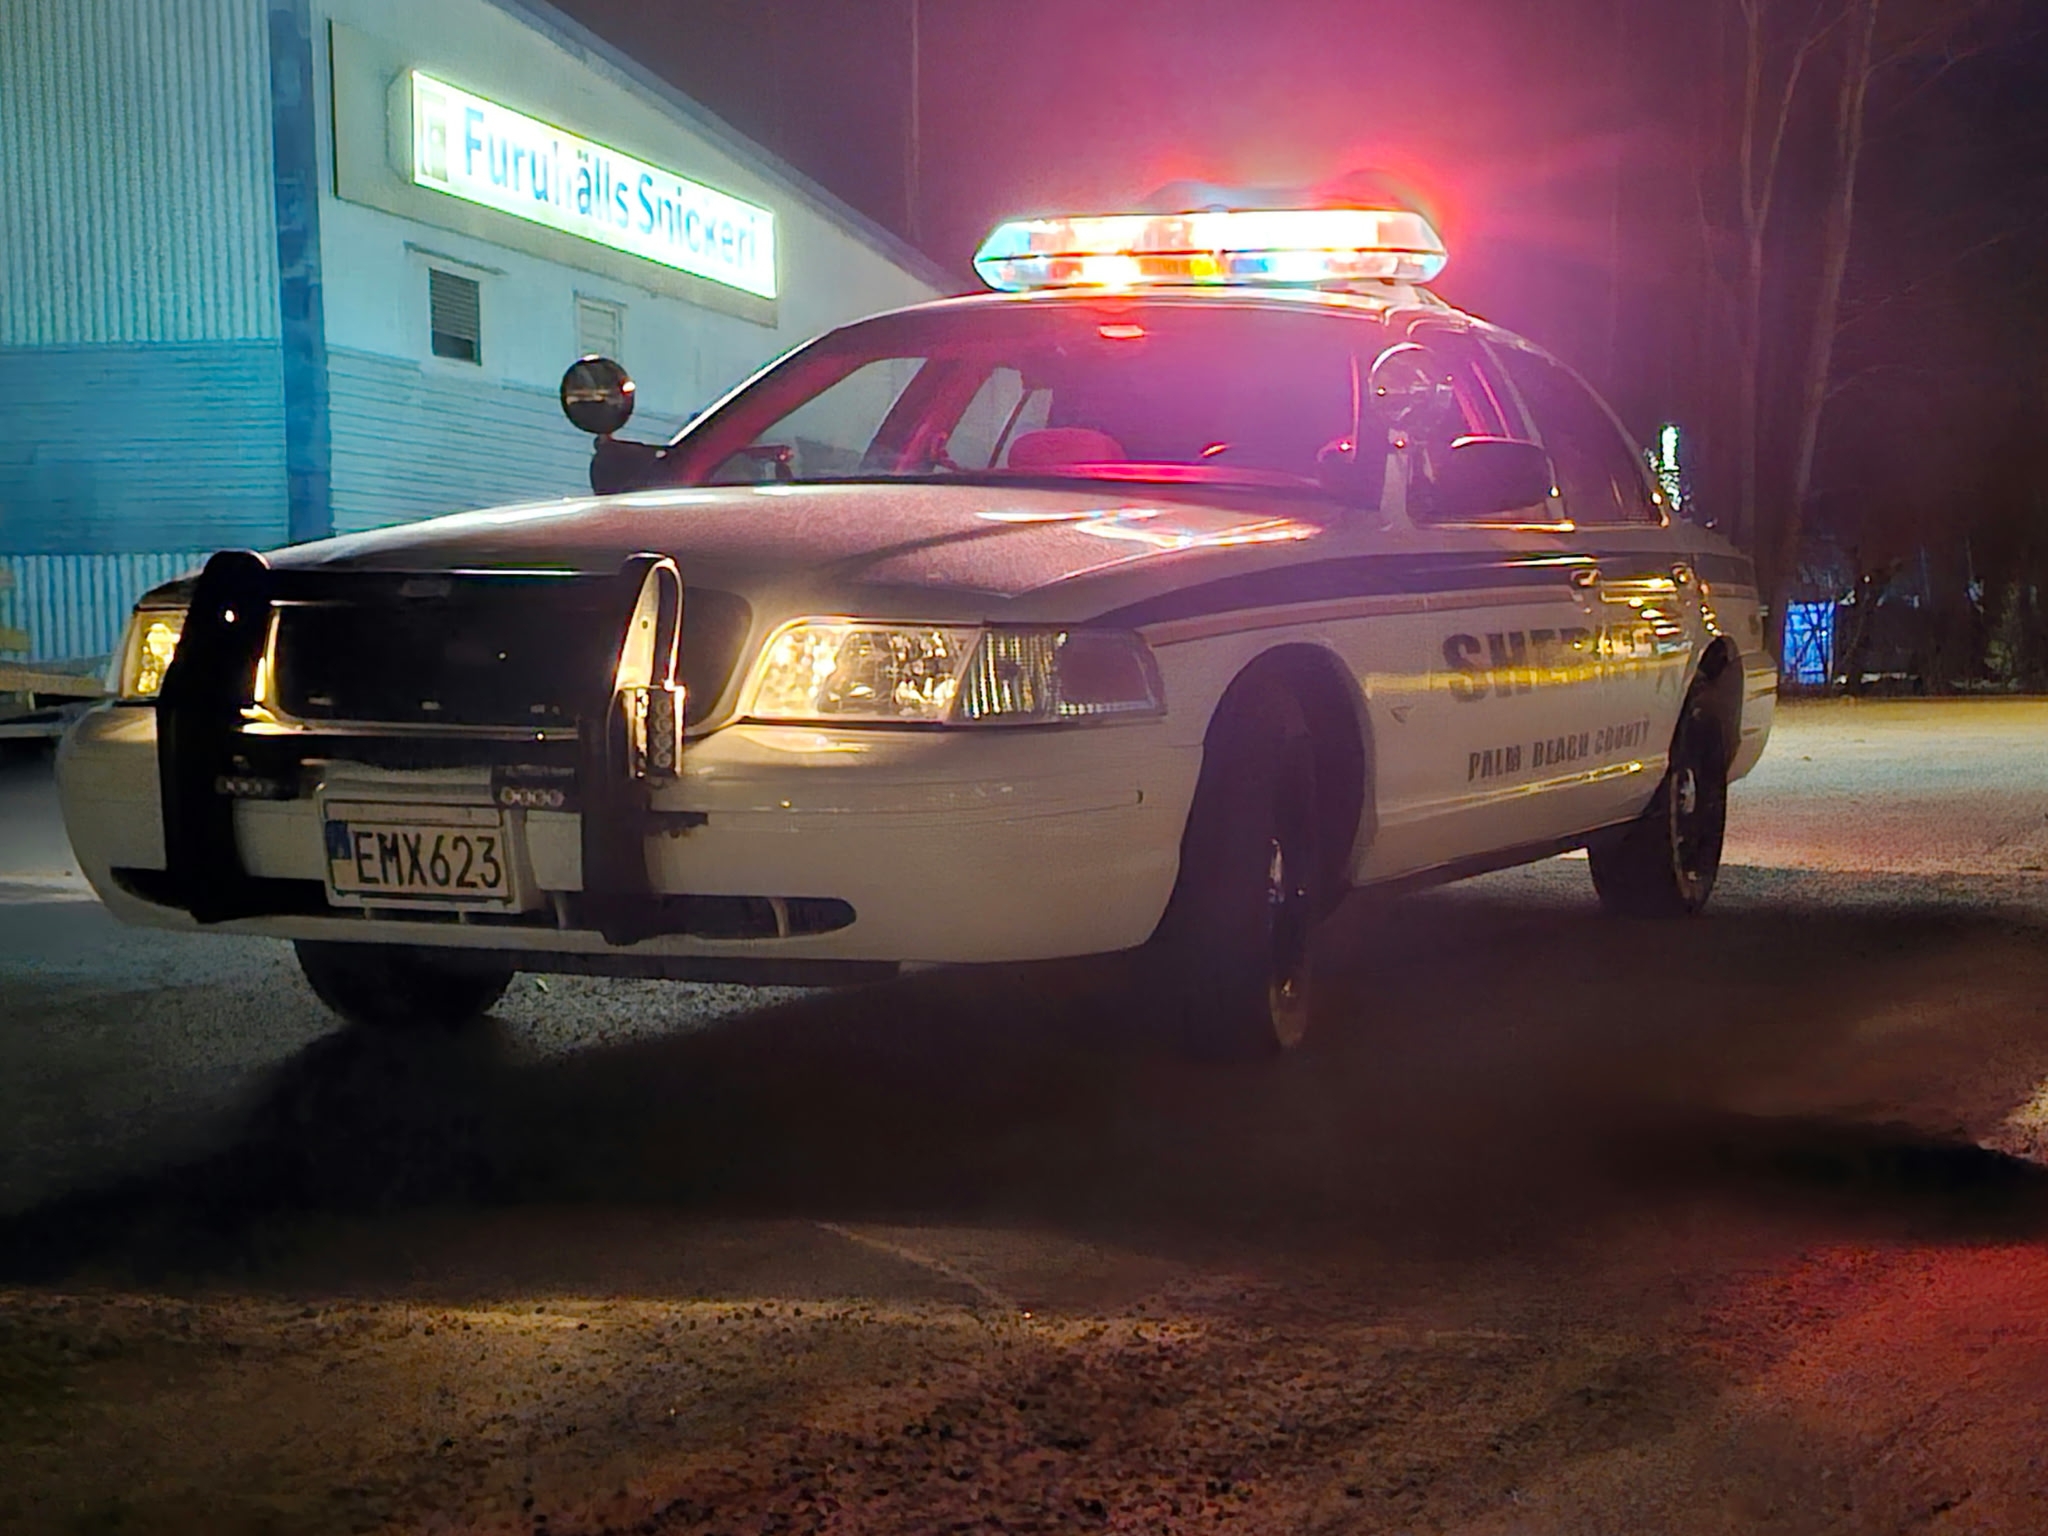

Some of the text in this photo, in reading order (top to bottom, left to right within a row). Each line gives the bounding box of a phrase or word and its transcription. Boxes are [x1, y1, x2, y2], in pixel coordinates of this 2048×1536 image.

[1442, 625, 1660, 702] SHER
[1467, 719, 1651, 782] PALM BEACH COUNTY
[351, 831, 501, 889] EMX623
